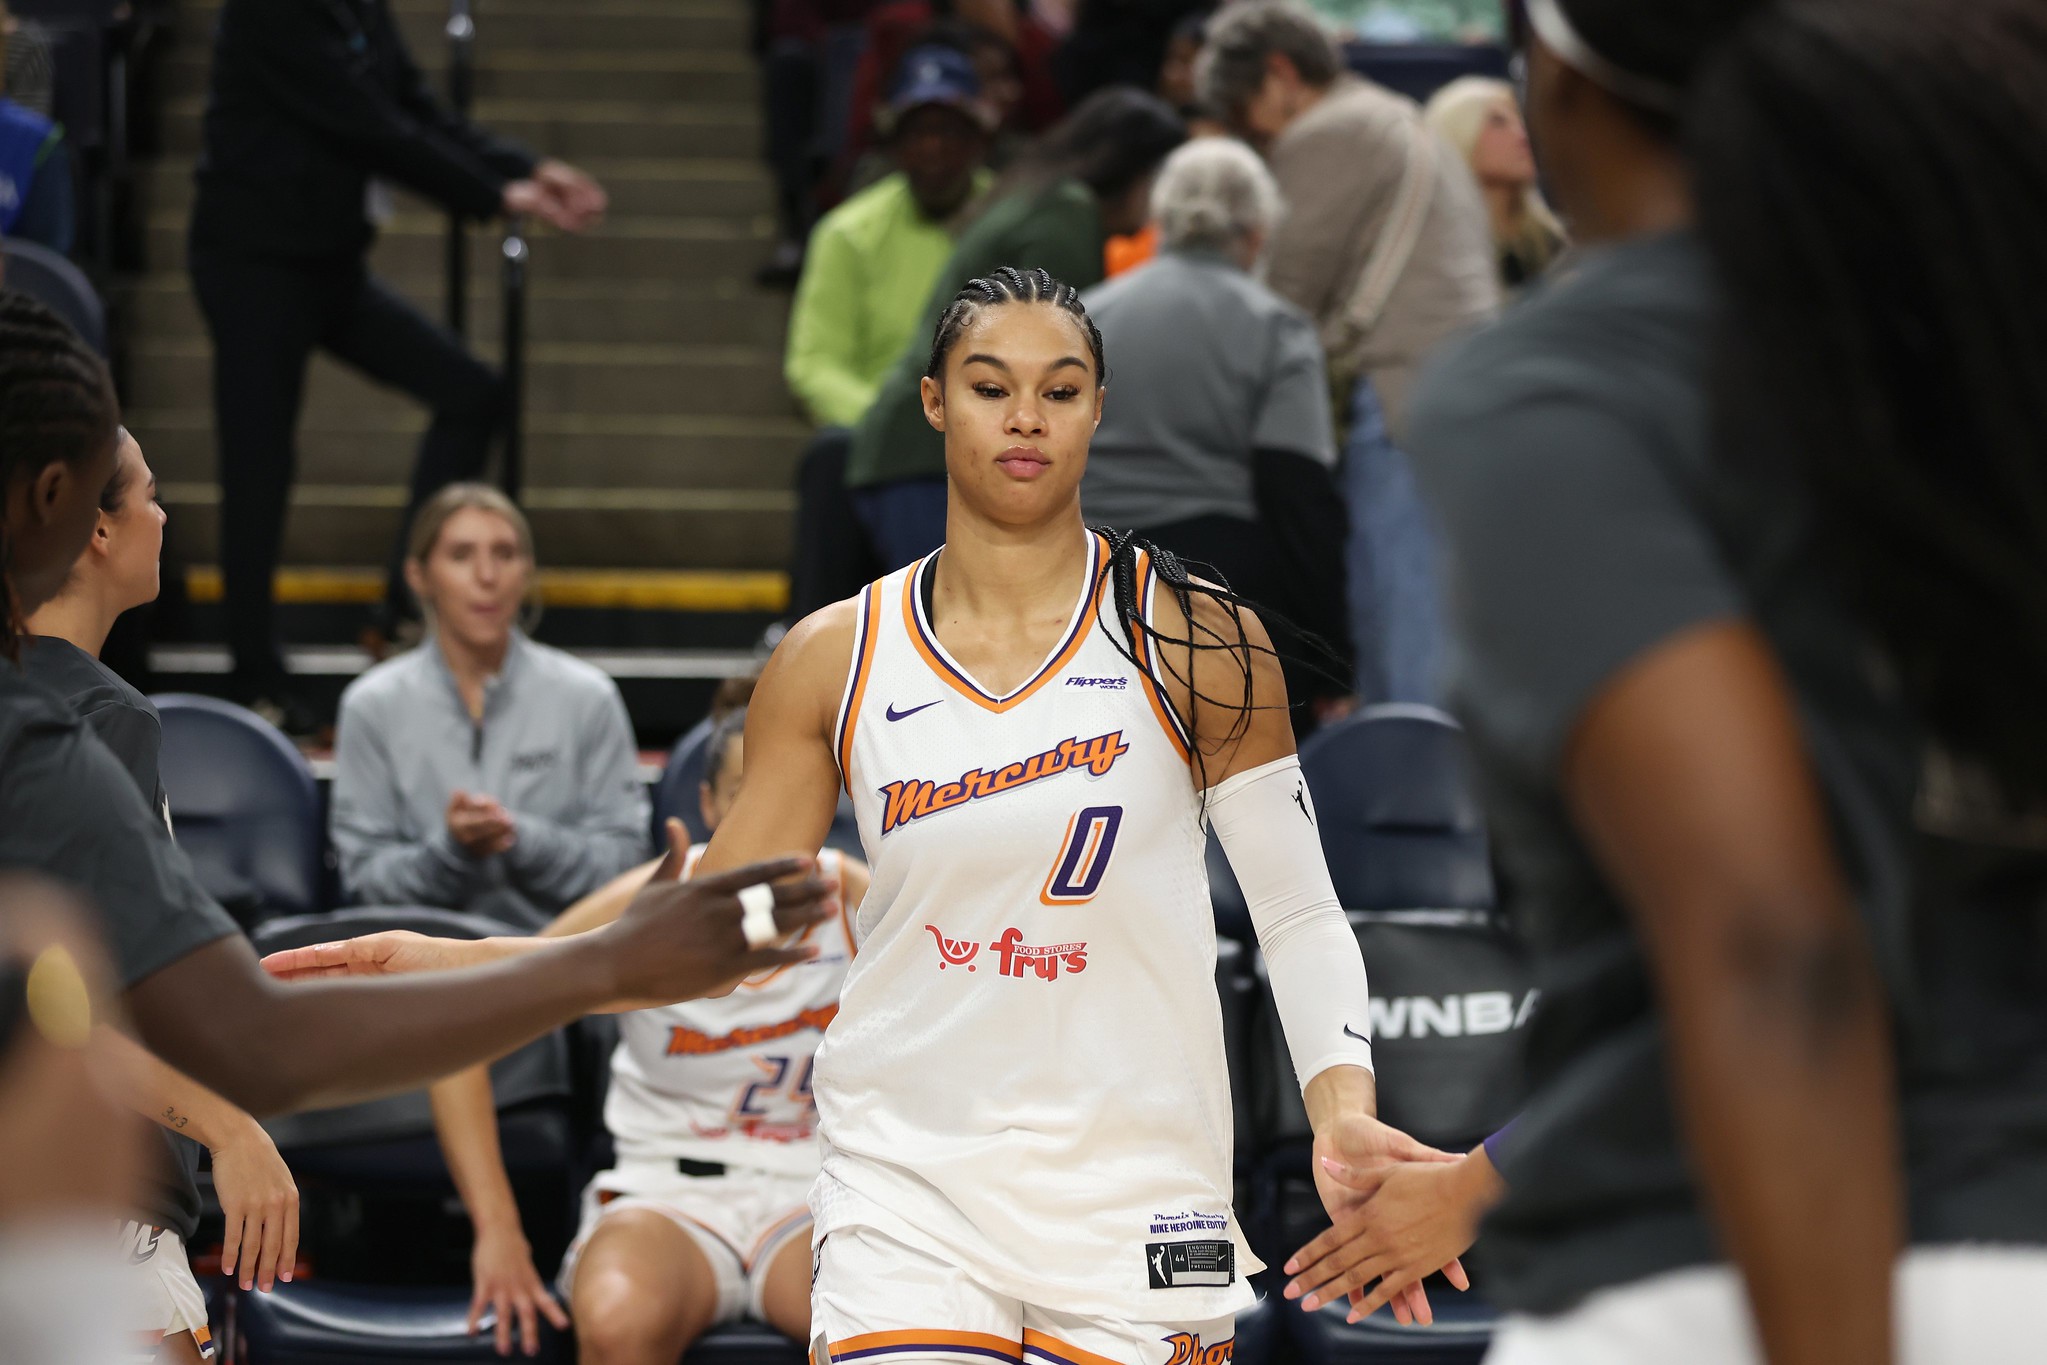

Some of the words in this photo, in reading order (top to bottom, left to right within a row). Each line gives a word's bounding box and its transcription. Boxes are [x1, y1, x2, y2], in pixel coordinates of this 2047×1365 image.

[876, 729, 1130, 838] Mercury
[1039, 805, 1124, 906] 0
[989, 927, 1088, 982] fry's
[1014, 945, 1040, 955] FOOD
[1043, 943, 1082, 955] STORES
[176, 1117, 188, 1128] 3
[1149, 1223, 1169, 1234] NIKE
[1170, 1220, 1206, 1233] HEROINE
[1175, 1254, 1185, 1262] 44
[1161, 1332, 1235, 1365] Pho
